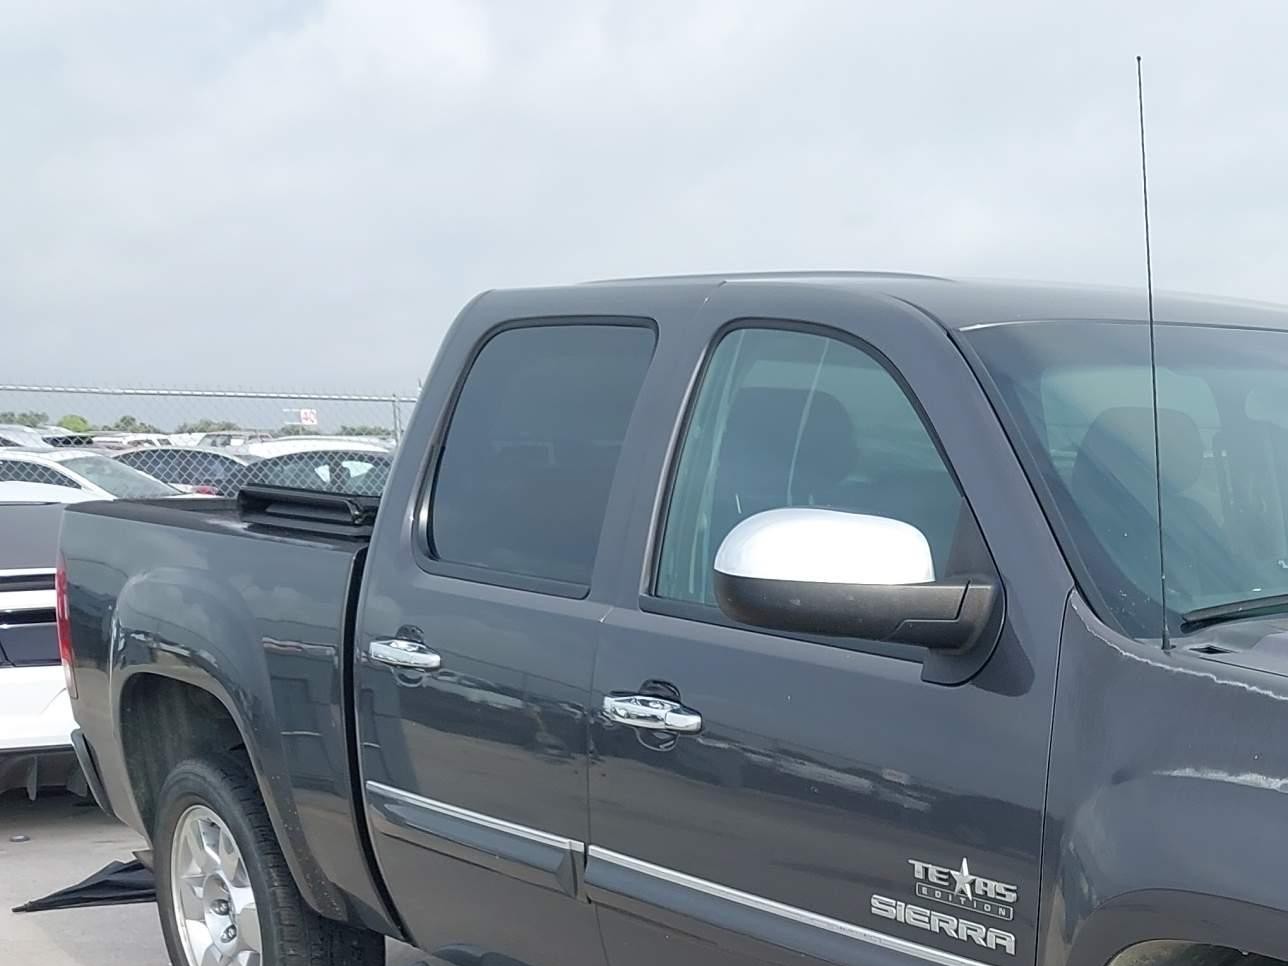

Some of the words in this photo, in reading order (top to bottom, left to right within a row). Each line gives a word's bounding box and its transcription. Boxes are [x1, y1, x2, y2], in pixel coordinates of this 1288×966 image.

[907, 857, 1017, 904] TEXAS
[921, 886, 1007, 917] EDITION
[870, 894, 1017, 956] SIERRA
